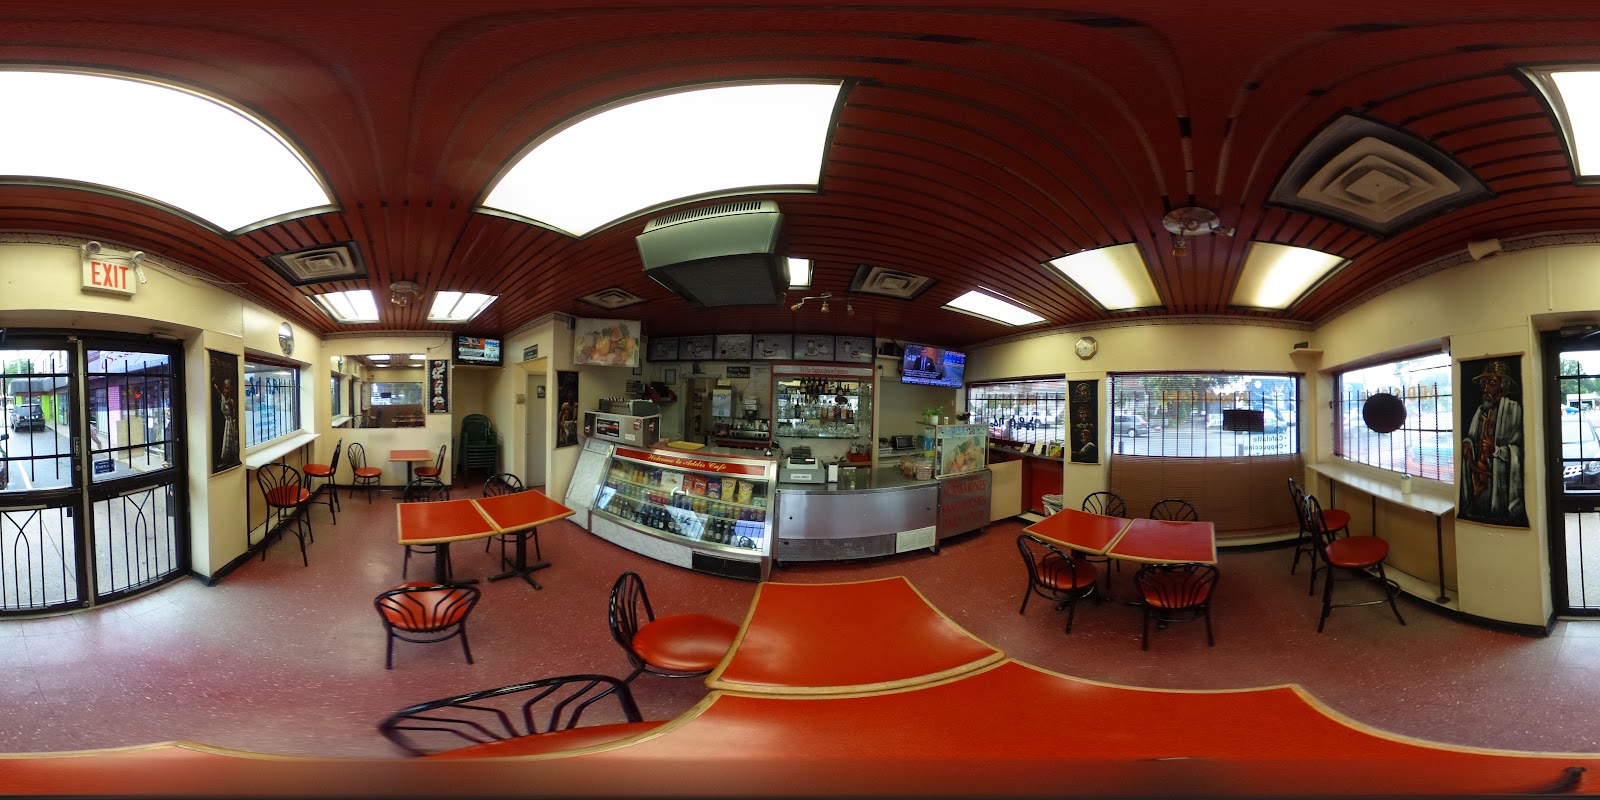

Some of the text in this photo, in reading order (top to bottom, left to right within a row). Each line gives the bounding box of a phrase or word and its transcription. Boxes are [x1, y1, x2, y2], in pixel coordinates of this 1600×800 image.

[91, 261, 129, 290] EXIT
[648, 454, 675, 464] Welcome
[682, 459, 706, 468] Addis
[943, 479, 986, 497] SUBMARINES
[941, 496, 986, 513] SANDWICHES
